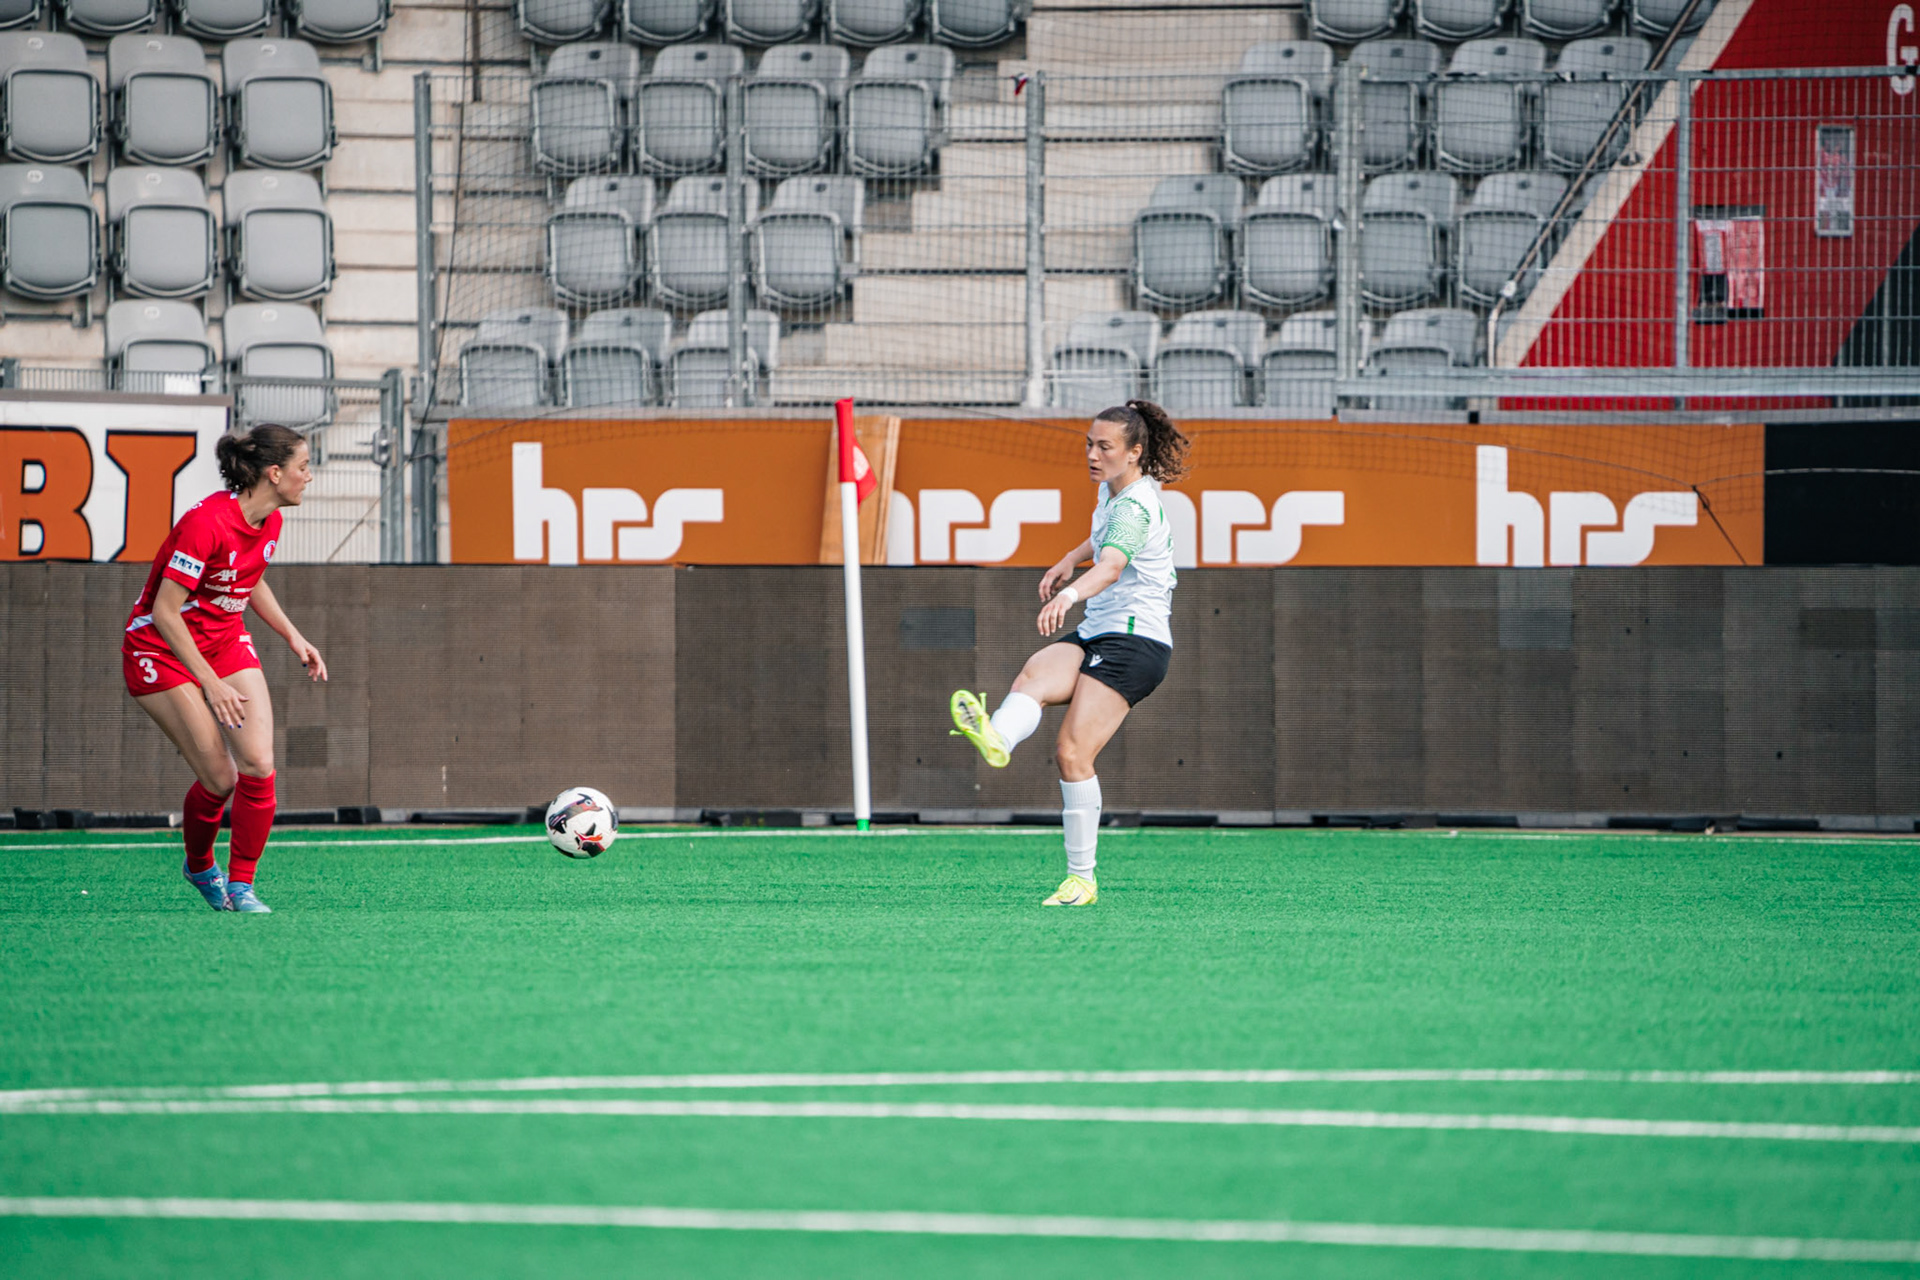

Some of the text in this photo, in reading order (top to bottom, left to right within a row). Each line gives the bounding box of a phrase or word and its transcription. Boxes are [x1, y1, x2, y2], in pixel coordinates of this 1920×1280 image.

[512, 442, 724, 566] hrs
[1476, 444, 1698, 567] hrs
[138, 657, 158, 684] 3
